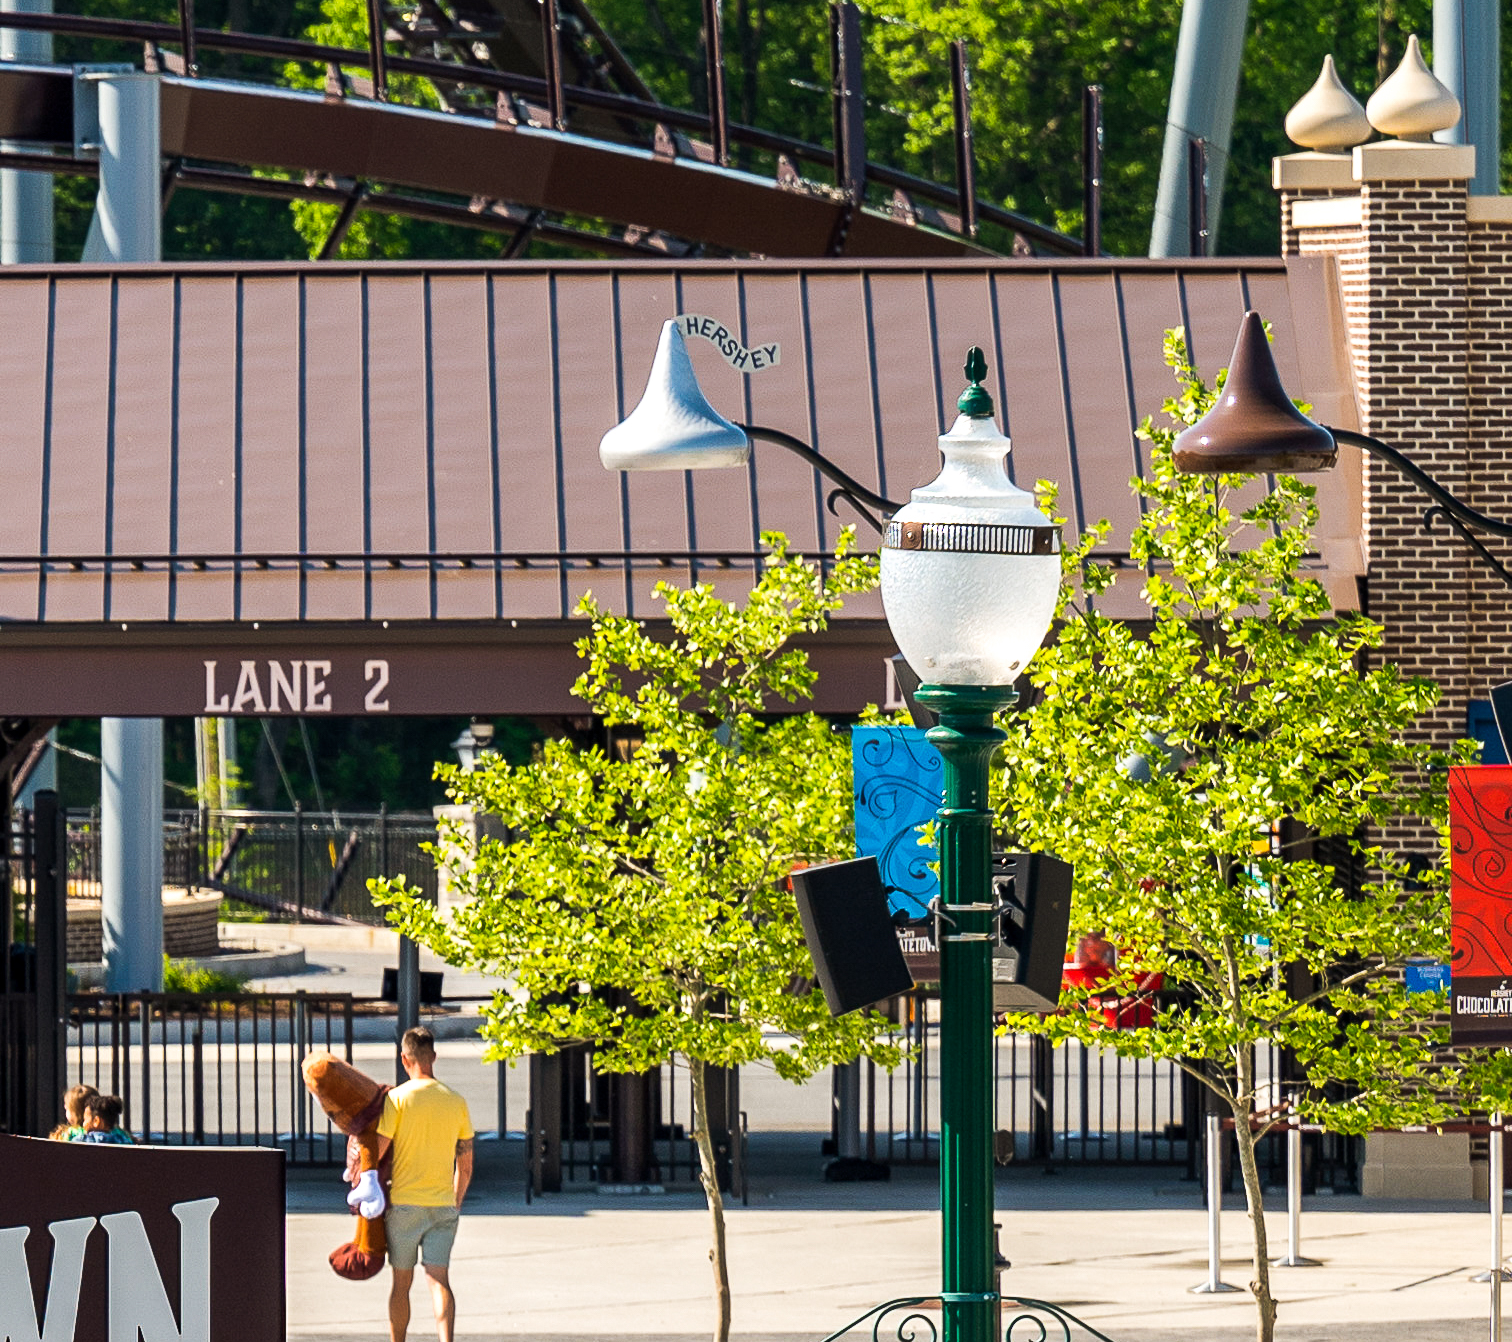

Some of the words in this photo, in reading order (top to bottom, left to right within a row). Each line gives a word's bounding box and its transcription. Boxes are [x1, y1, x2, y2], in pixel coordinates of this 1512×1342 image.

[686, 316, 777, 369] HERSHEY
[203, 660, 332, 712] LANE
[364, 660, 390, 712] 2
[1457, 995, 1512, 1014] CHOCOLAT
